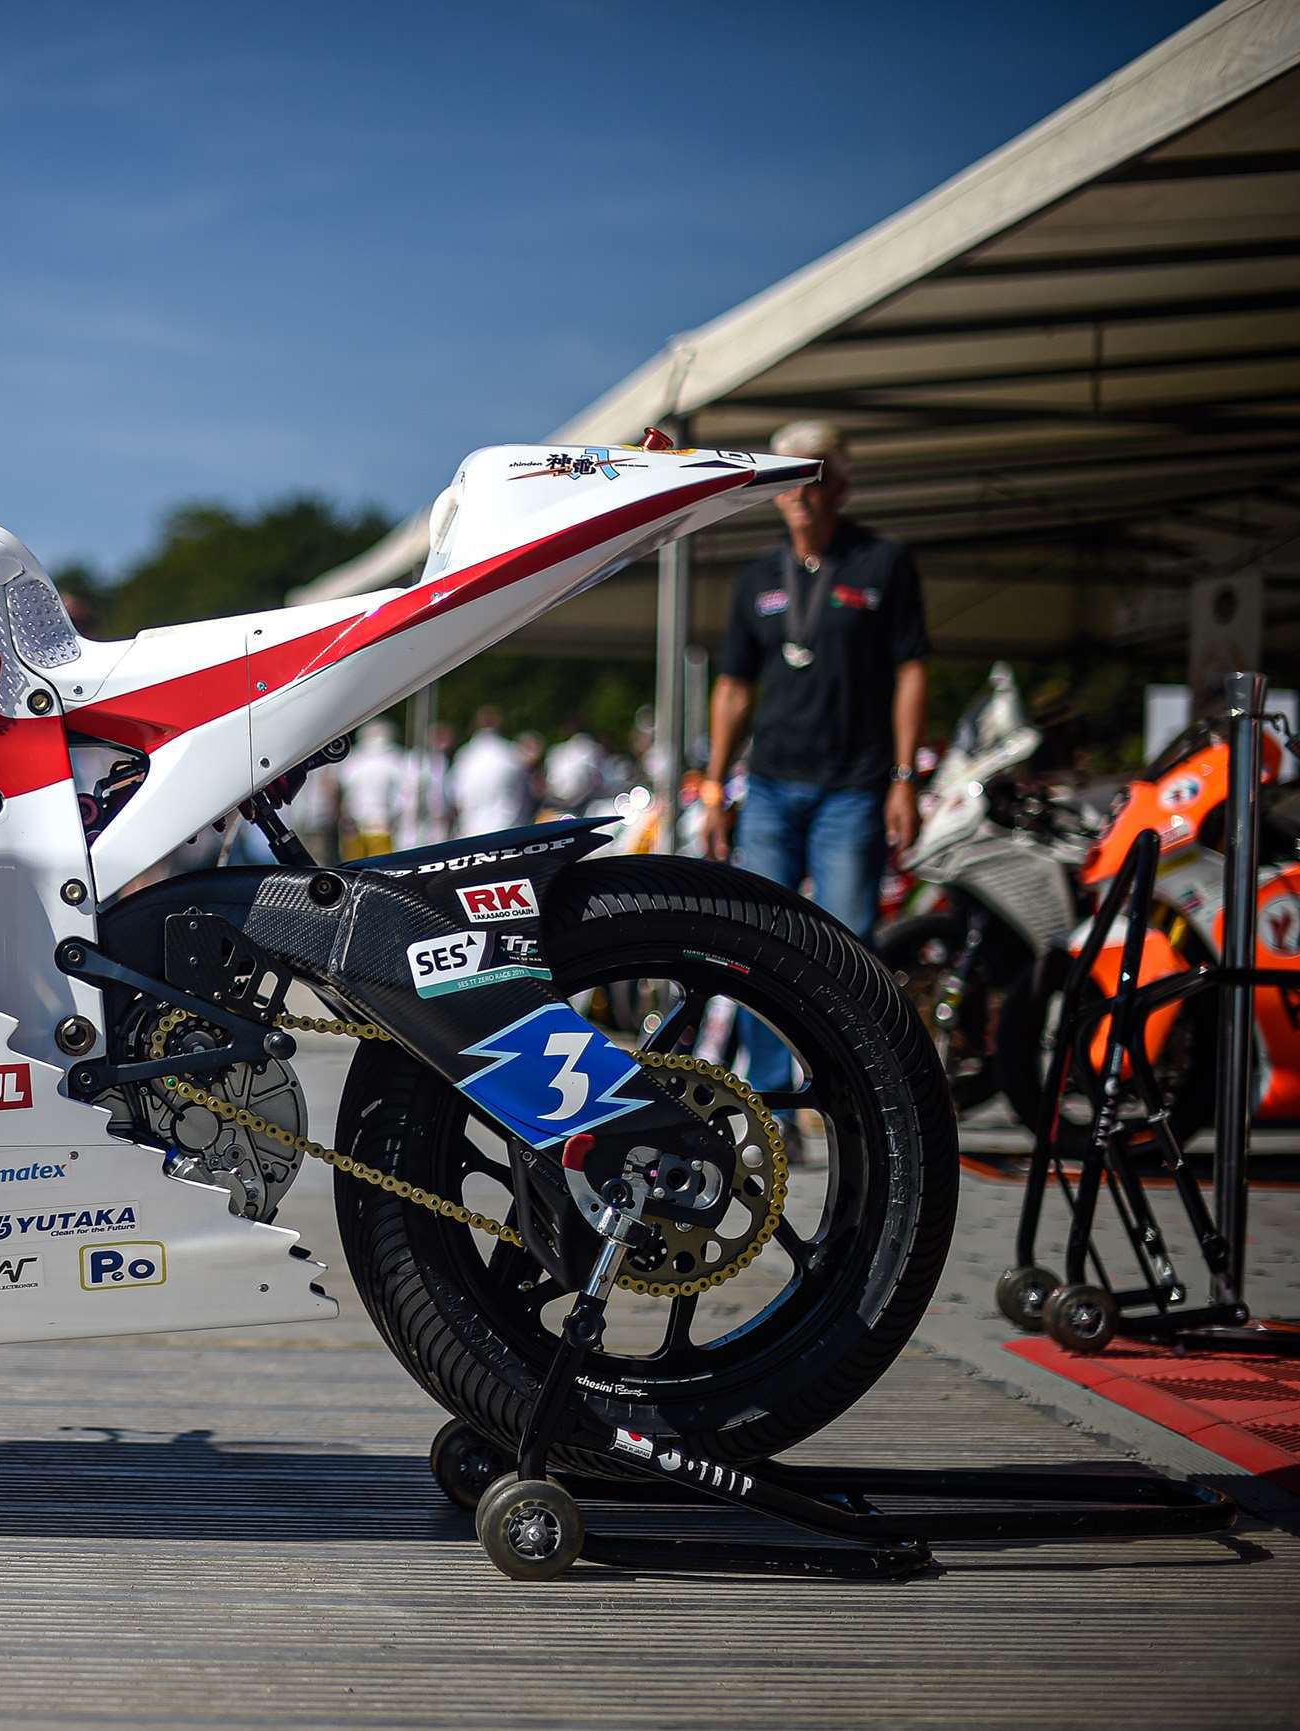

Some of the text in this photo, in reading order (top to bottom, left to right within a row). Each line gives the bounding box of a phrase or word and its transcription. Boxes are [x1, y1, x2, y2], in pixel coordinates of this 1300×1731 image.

[417, 836, 576, 875] DUNLOP
[463, 883, 532, 914] RK
[473, 908, 534, 921] TAKASAGO CHAIN
[415, 943, 468, 976] SES
[501, 935, 538, 956] TT
[535, 1032, 594, 1121] 3
[16, 1207, 137, 1232] YUTAKA
[50, 1222, 136, 1237] Clean for the Future
